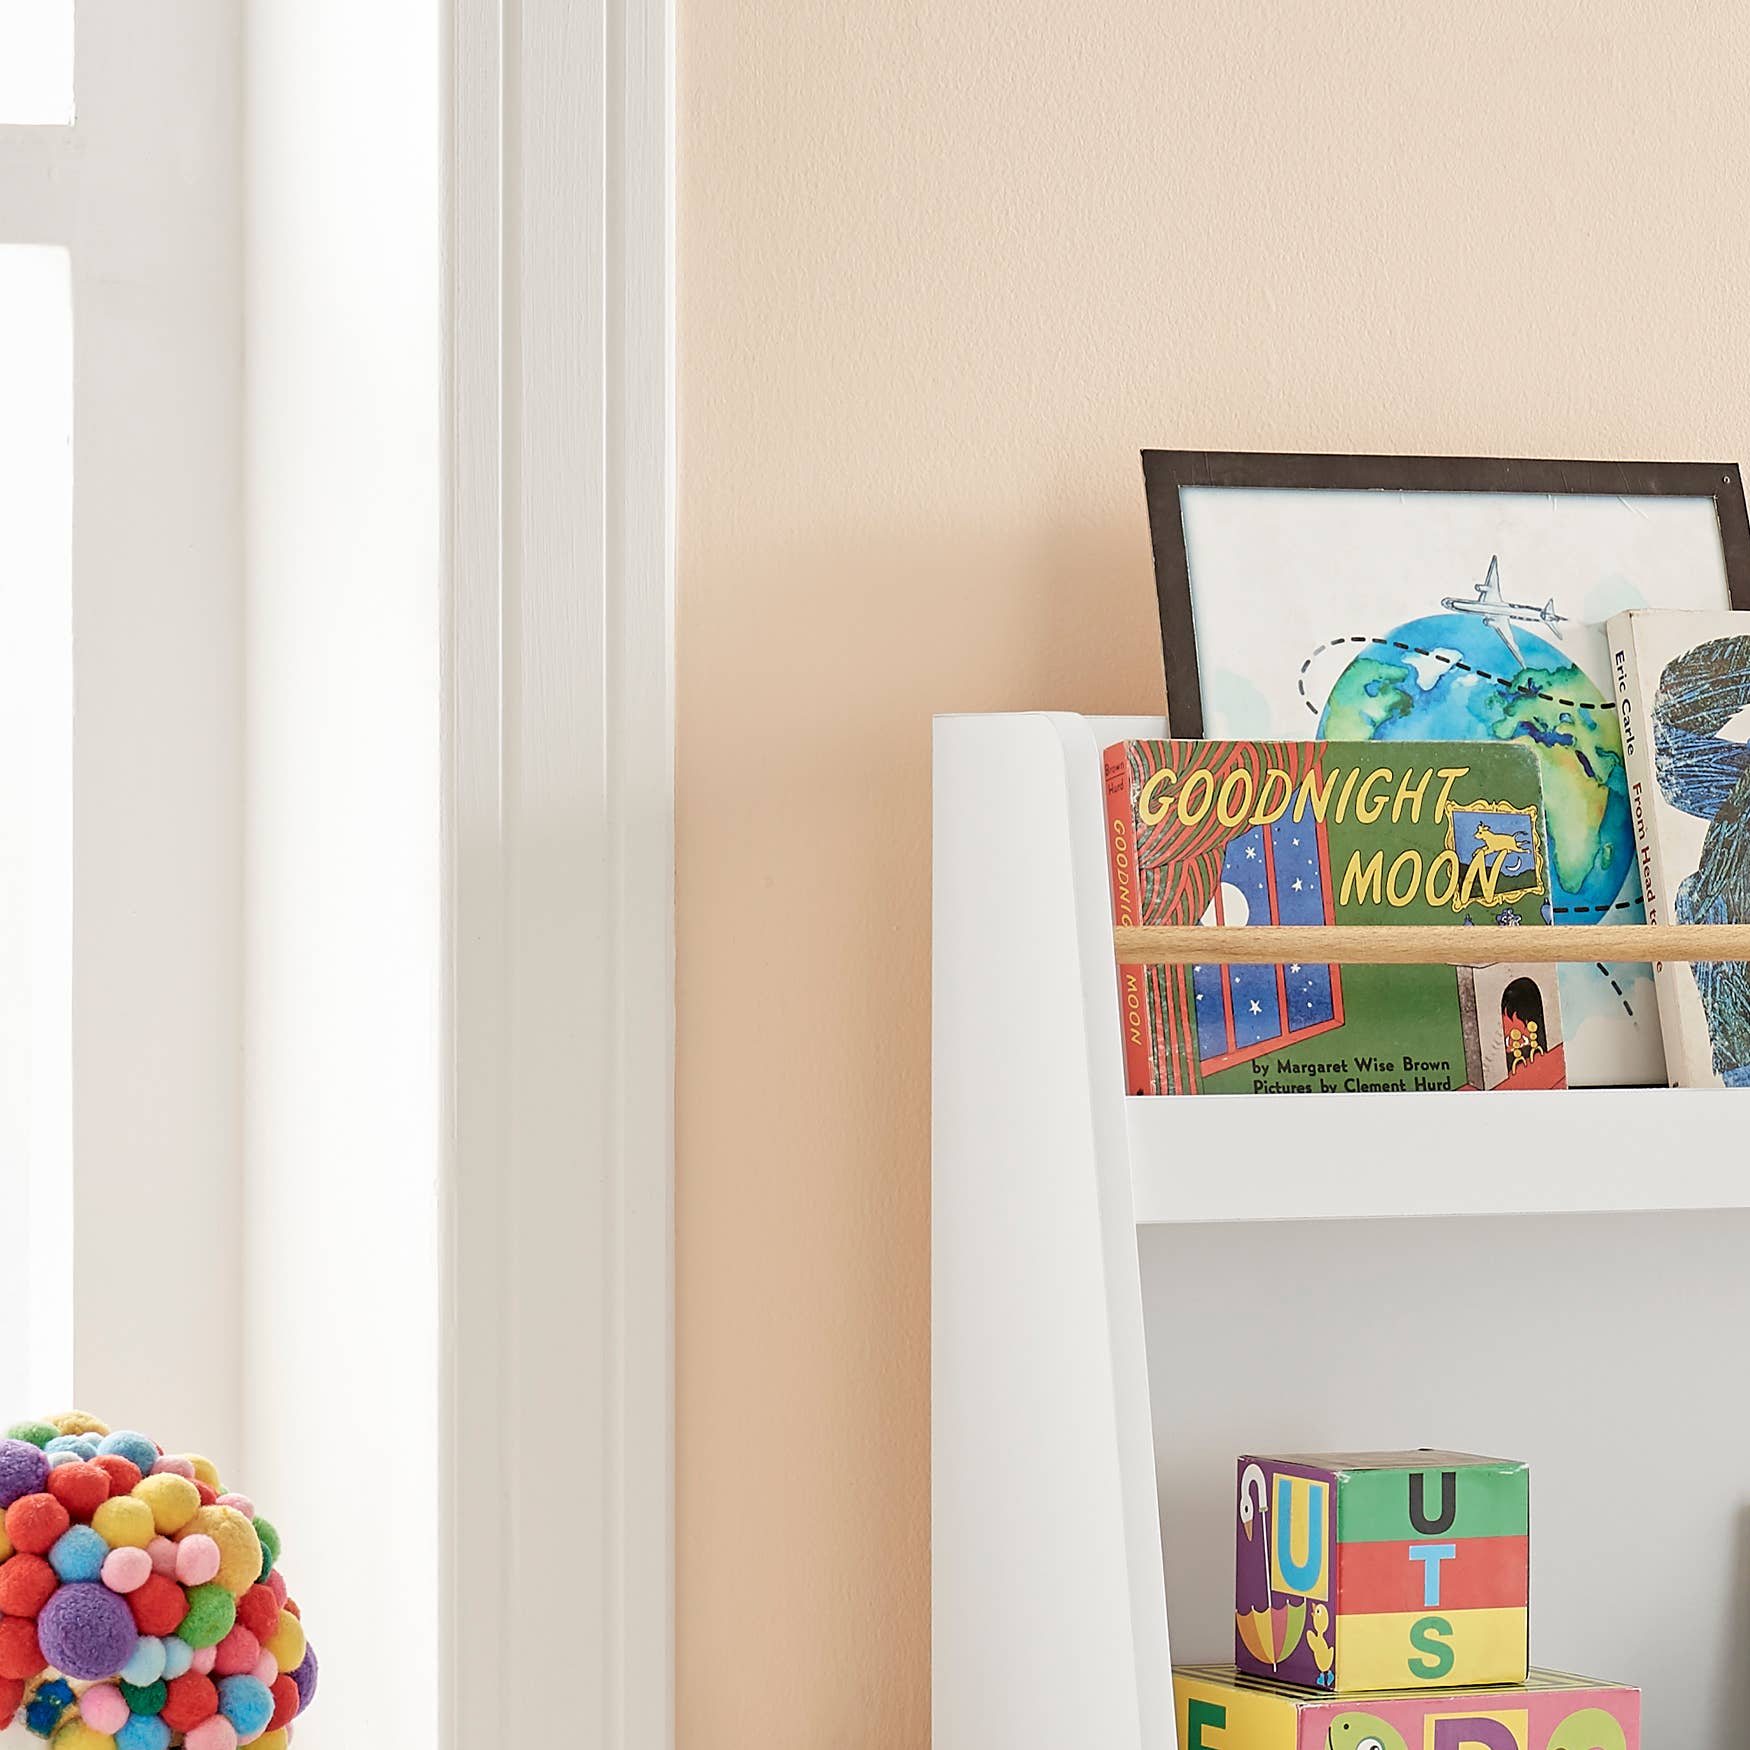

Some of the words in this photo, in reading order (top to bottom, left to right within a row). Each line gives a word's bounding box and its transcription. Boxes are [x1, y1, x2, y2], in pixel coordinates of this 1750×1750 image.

[1104, 761, 1125, 777] Brown
[1107, 779, 1125, 795] Hurd
[1138, 766, 1470, 828] GOODNIGHT
[1615, 650, 1628, 693] Eric
[1622, 698, 1636, 756] Carle
[1632, 782, 1649, 841] From
[1641, 847, 1656, 903] Head
[1339, 849, 1510, 907] MOON
[1113, 818, 1134, 927] GOODNIG
[1126, 974, 1142, 1045] MOON
[1252, 1058, 1269, 1077] by
[1277, 1058, 1349, 1077] Margaret
[1354, 1056, 1395, 1072] Wise
[1402, 1056, 1450, 1072] Brown
[1253, 1079, 1313, 1094] Pictures
[1343, 1077, 1406, 1093] Clement
[1414, 1076, 1451, 1092] Hurd
[1409, 1472, 1457, 1535] U
[1278, 1478, 1323, 1592] U
[1409, 1543, 1457, 1607] T
[1408, 1616, 1456, 1680] S
